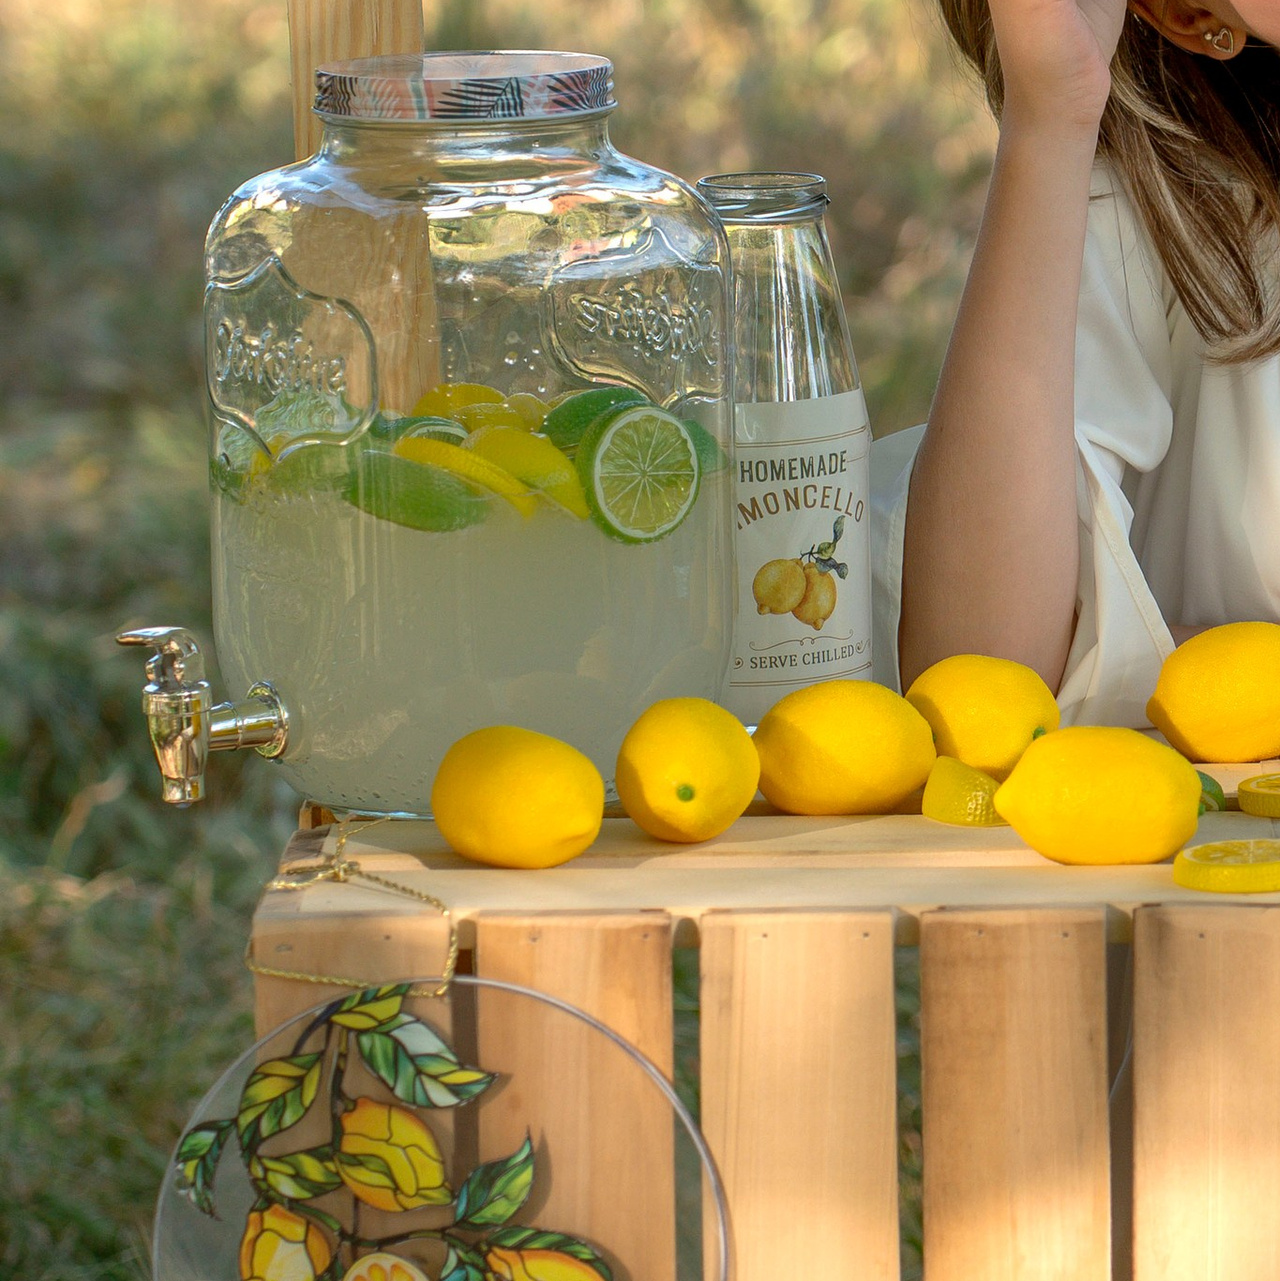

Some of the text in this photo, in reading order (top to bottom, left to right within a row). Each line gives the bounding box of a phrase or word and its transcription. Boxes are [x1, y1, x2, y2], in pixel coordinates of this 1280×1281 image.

[740, 450, 848, 483] HOMEMADE
[736, 484, 865, 530] MONCELLO
[749, 644, 855, 670] SERVE CHILLED
